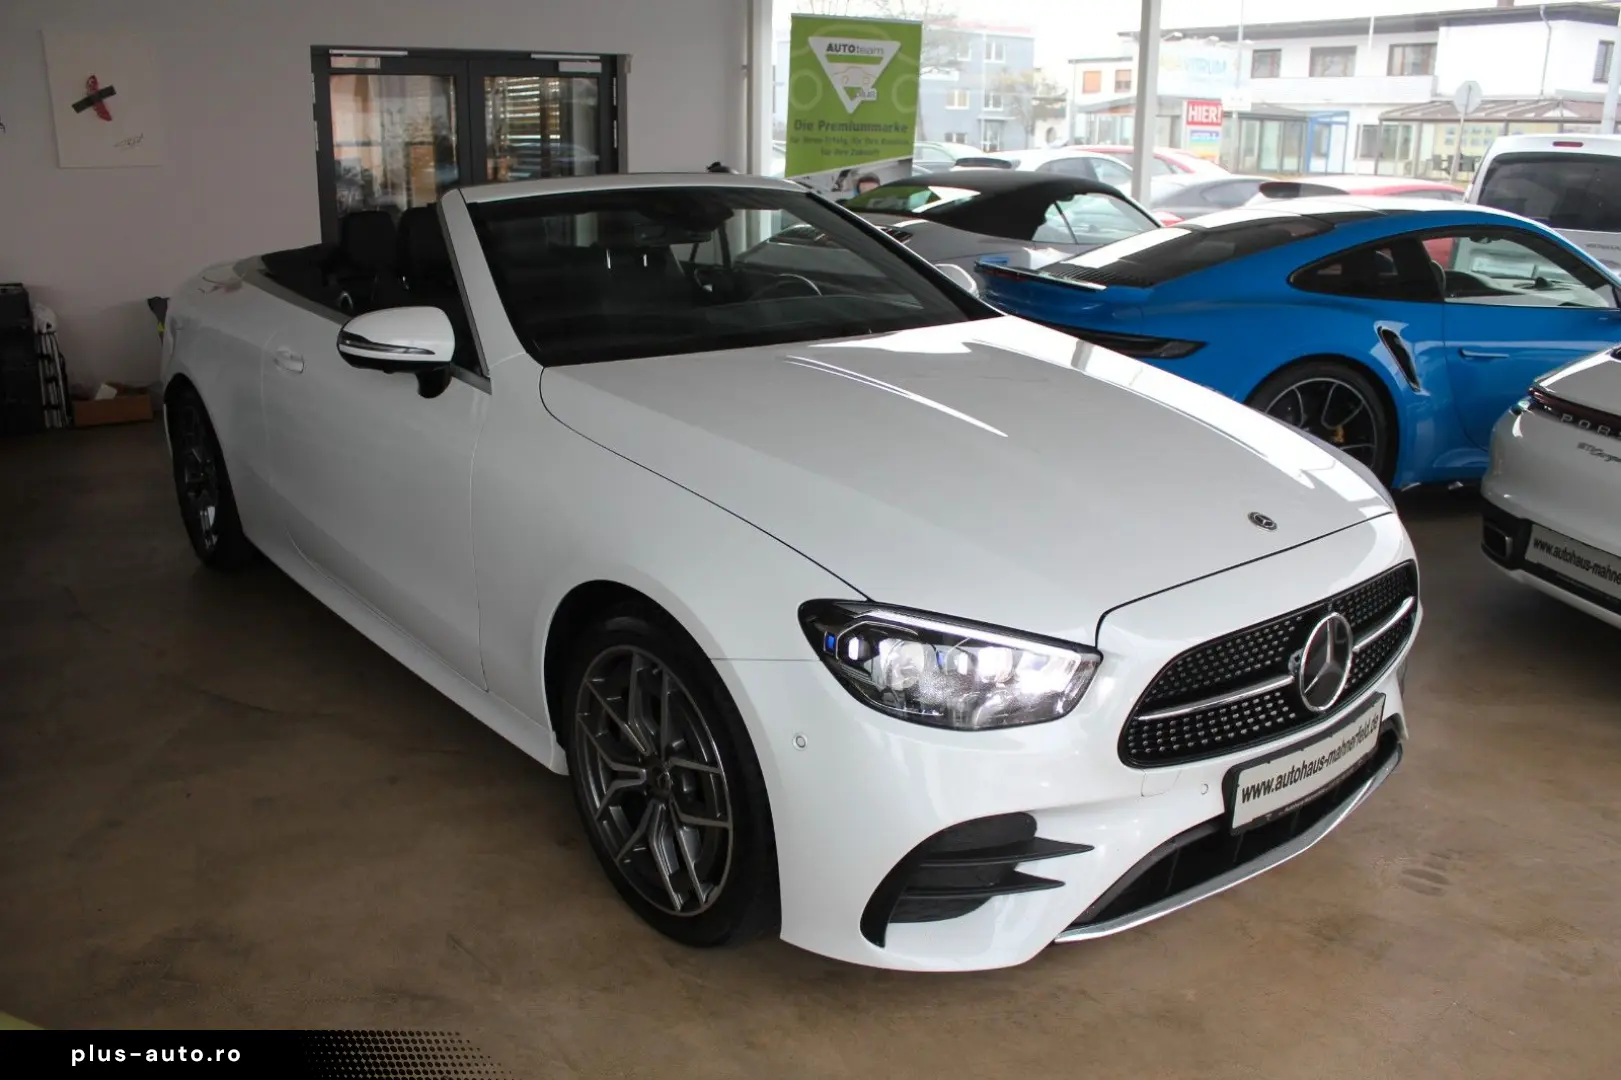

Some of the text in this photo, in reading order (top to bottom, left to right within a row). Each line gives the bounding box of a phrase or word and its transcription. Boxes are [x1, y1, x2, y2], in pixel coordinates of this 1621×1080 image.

[1188, 105, 1222, 123] HIER!
[794, 119, 908, 133] Die Premiummarke
[1560, 413, 1621, 438] POR
